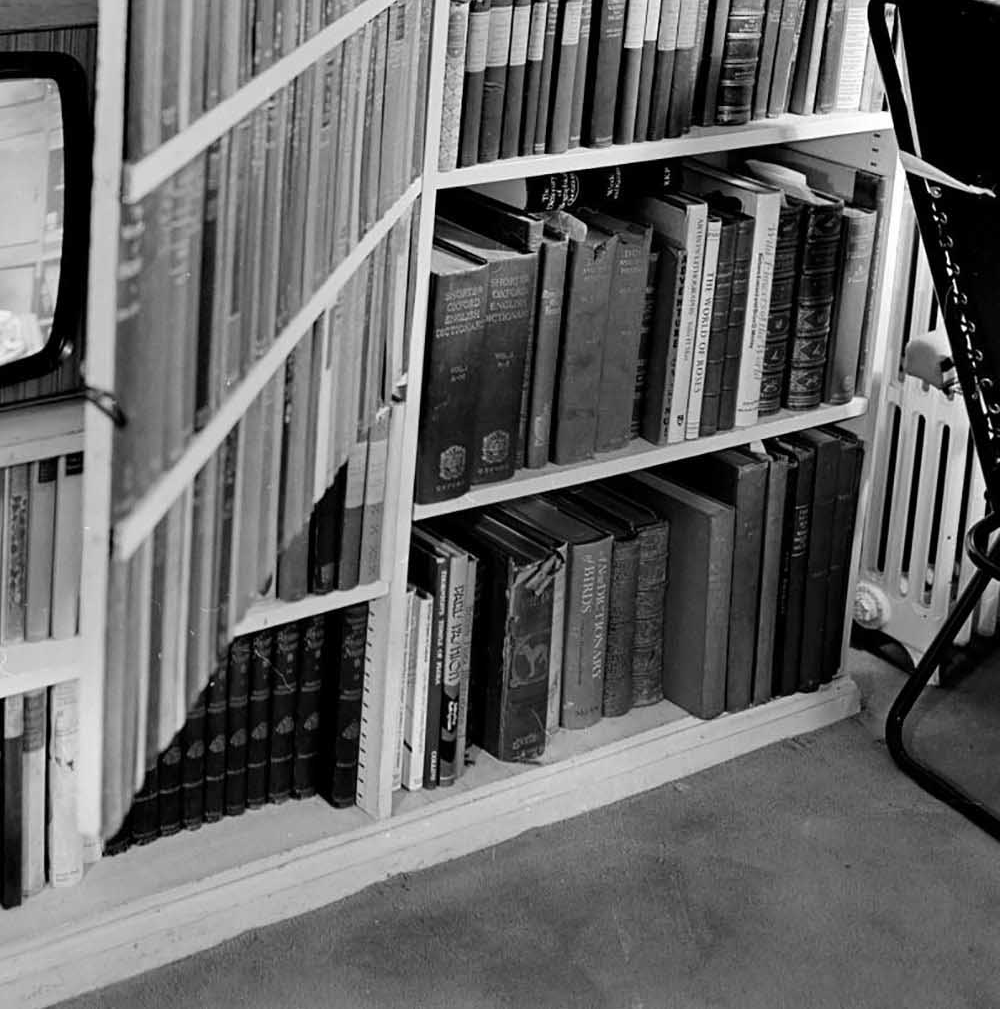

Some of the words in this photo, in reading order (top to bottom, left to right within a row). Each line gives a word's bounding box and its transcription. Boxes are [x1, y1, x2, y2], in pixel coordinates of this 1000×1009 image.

[706, 273, 715, 293] THE
[701, 296, 713, 338] WORLD
[698, 342, 706, 355] OF
[753, 345, 768, 380] World
[693, 360, 705, 393] ROSES
[435, 662, 443, 686] FLORA
